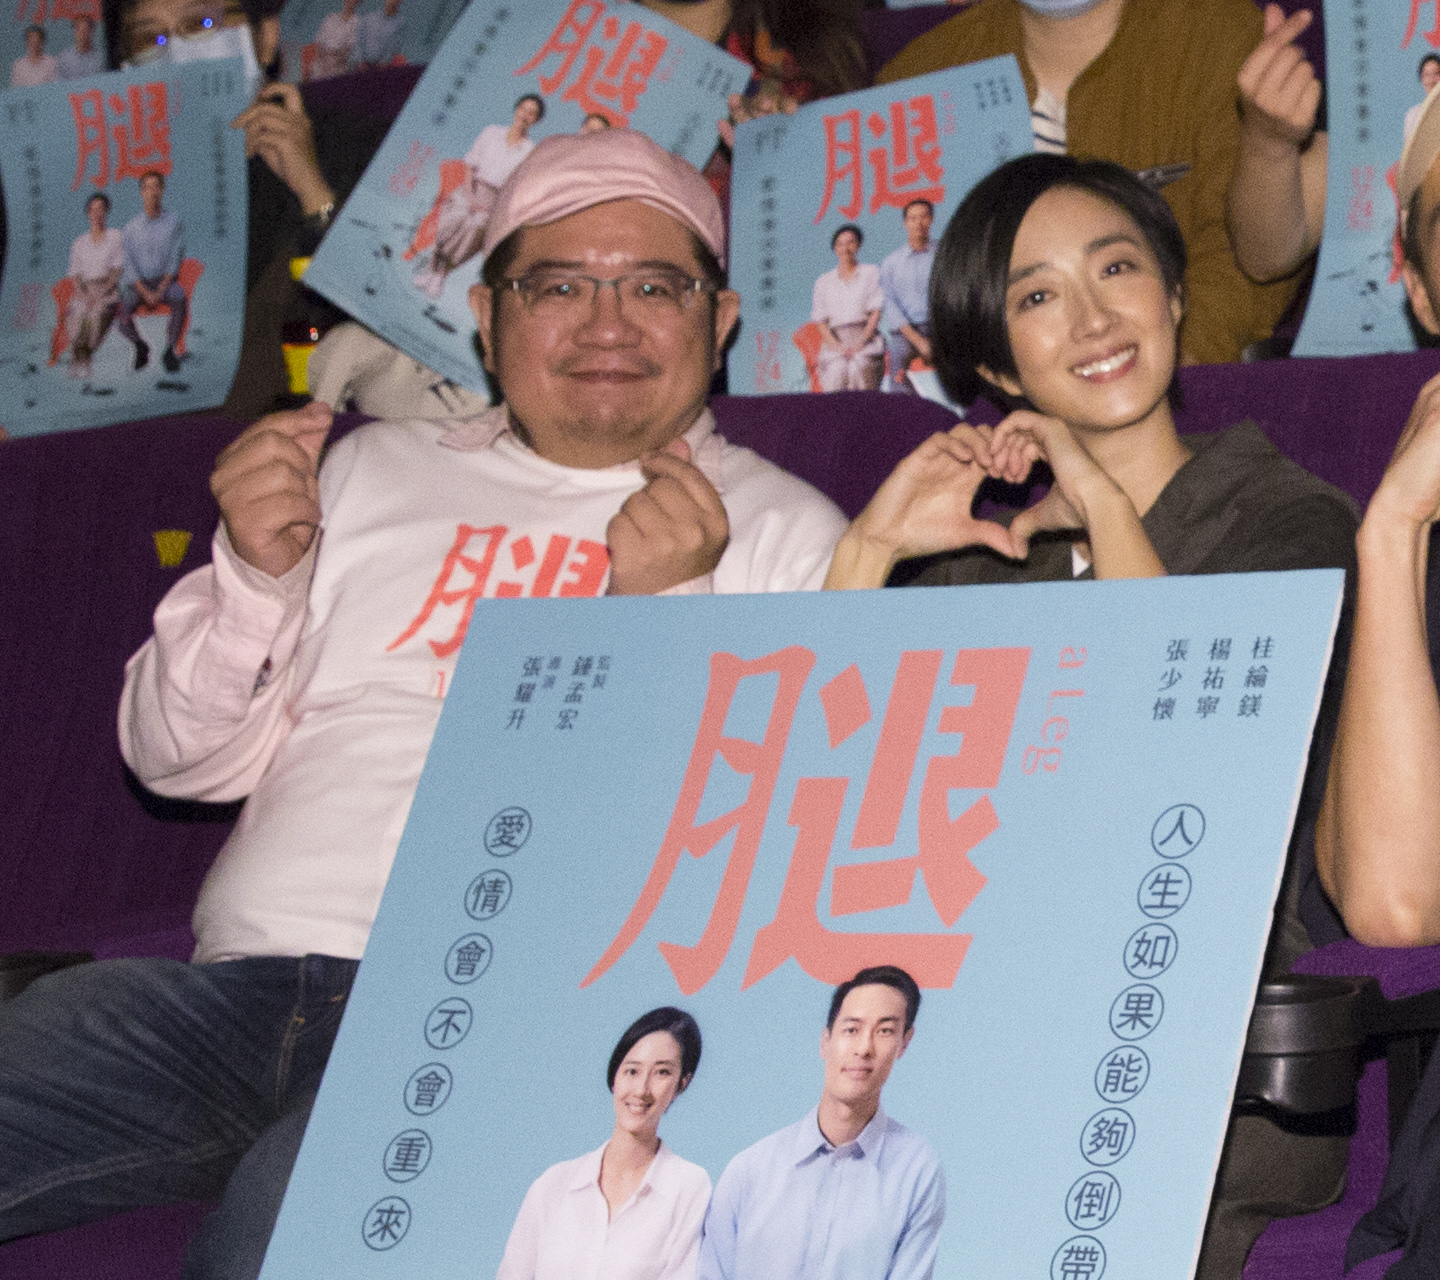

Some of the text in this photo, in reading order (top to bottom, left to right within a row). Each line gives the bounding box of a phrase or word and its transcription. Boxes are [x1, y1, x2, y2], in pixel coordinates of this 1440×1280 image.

[70, 81, 173, 192] 腿
[812, 94, 946, 225] 腿
[1022, 646, 1088, 775] a Leg
[1153, 639, 1190, 721] 張少懷
[1195, 638, 1232, 719] 楊祐寧
[1237, 636, 1274, 718] 桂綸鎂
[579, 646, 1032, 995] 腿
[362, 806, 532, 1252] 愛情會不會重來
